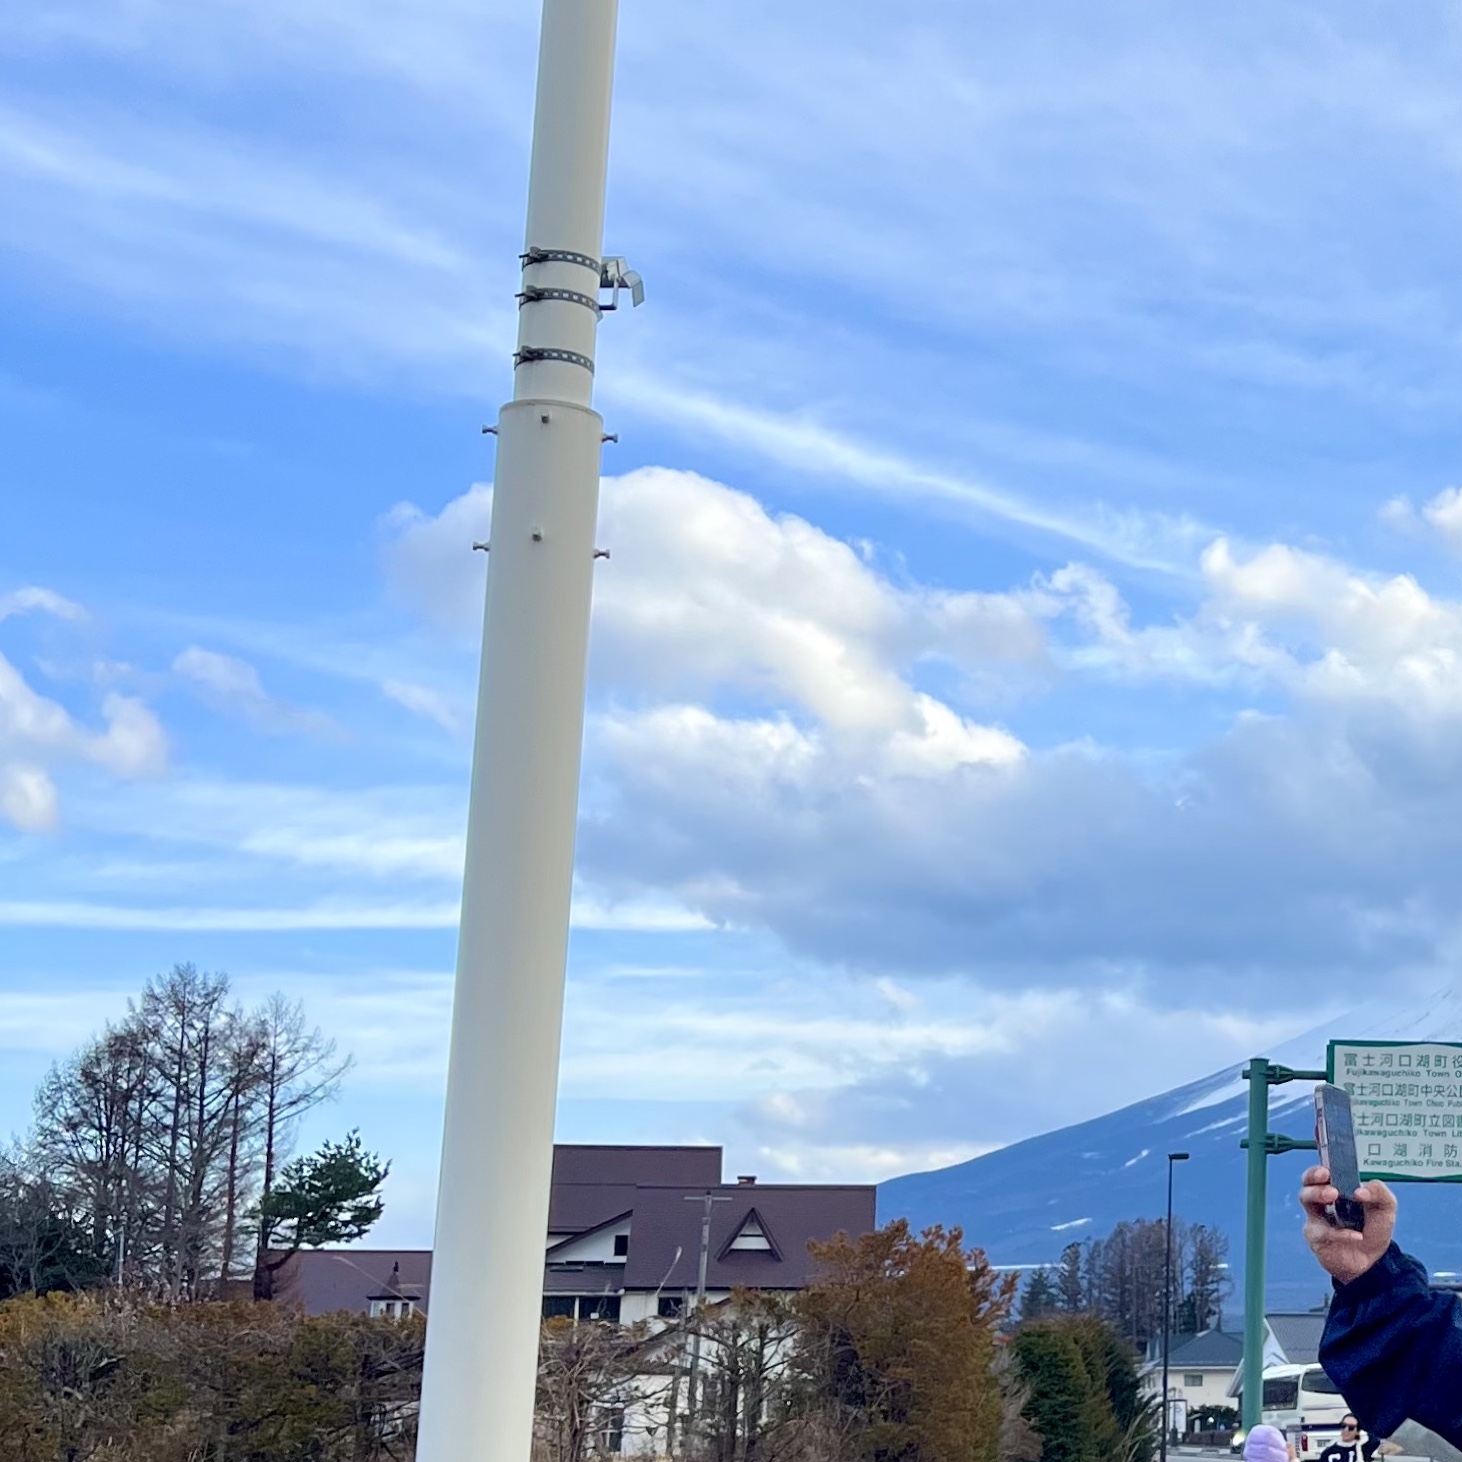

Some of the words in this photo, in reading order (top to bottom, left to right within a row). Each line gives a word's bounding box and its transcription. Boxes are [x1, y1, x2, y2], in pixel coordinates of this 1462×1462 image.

[1346, 1068, 1421, 1078] Fujikawaguchiko
[1426, 1069, 1450, 1077] Town
[1424, 1129, 1447, 1137] Town
[1363, 1158, 1424, 1168] Kawaguchiko
[1426, 1159, 1443, 1167] Fire
[1445, 1159, 1462, 1168] Sta.
